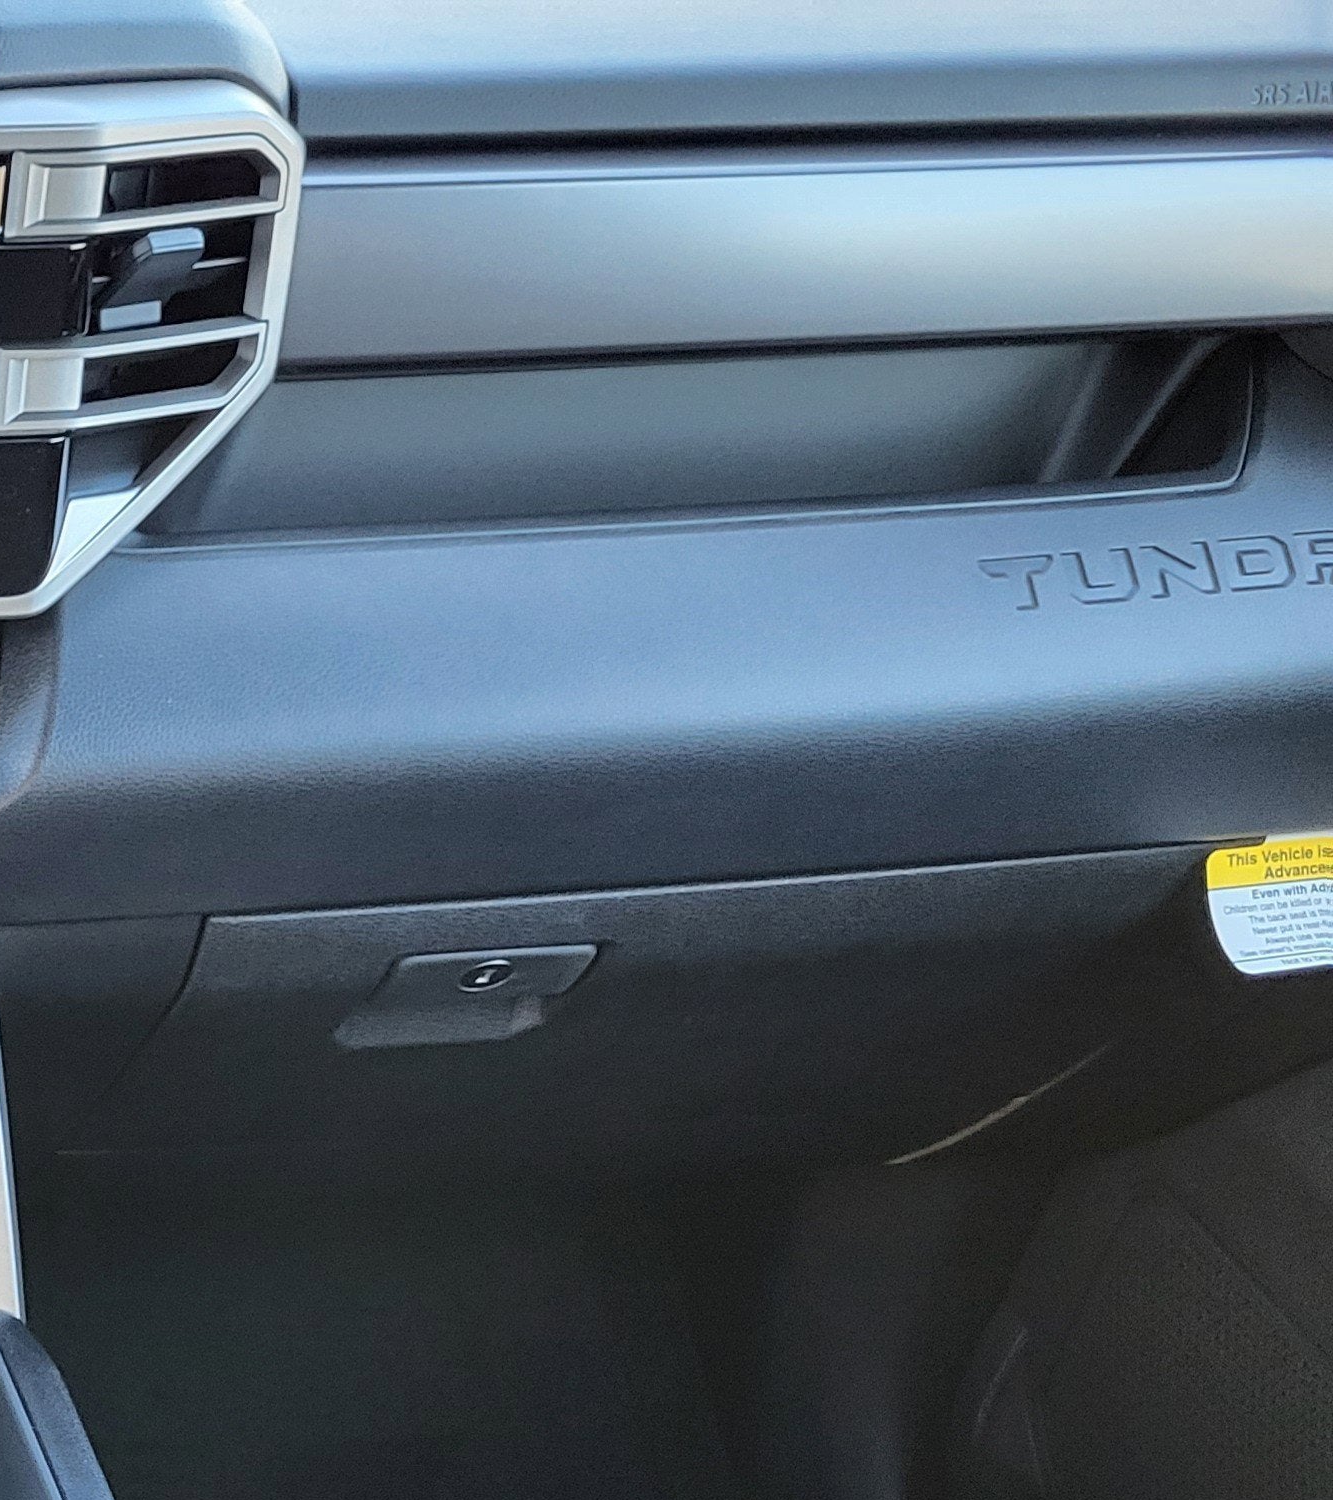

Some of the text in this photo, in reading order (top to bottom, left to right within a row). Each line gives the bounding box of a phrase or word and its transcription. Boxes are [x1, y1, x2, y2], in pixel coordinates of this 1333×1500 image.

[1227, 852, 1258, 867] This
[1262, 846, 1314, 863] Vehicle
[1252, 889, 1281, 900] Even
[1284, 884, 1308, 896] with
